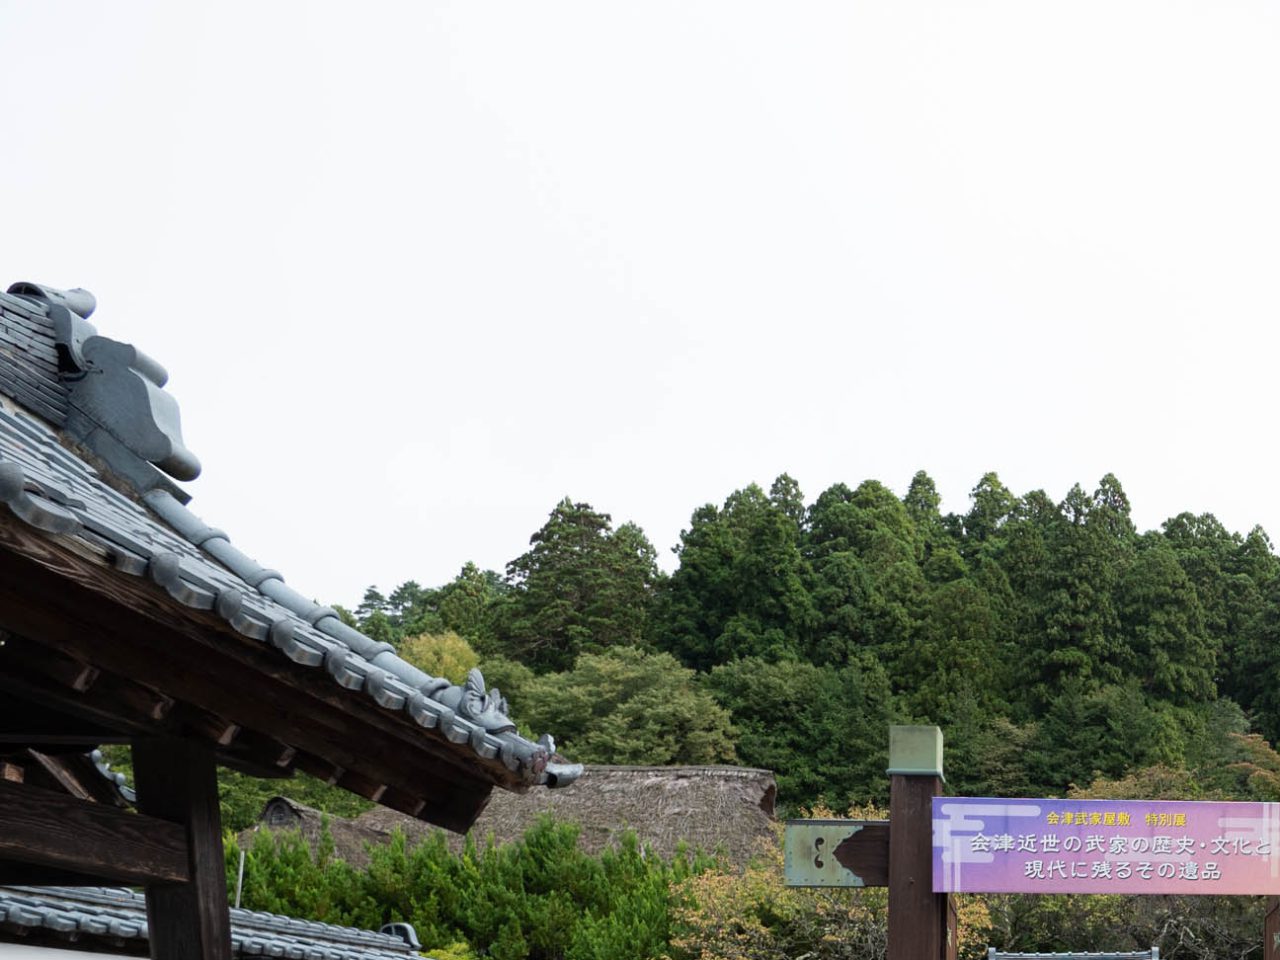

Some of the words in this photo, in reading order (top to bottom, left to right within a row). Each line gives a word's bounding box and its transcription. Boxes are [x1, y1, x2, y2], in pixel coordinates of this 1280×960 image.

[1046, 812, 1131, 827] 会津武家屋敷
[1145, 812, 1187, 827] 特別展
[969, 832, 1272, 856] 会津近世の武家の歴史・文化と
[1024, 859, 1222, 881] 現代に残るその遺品
